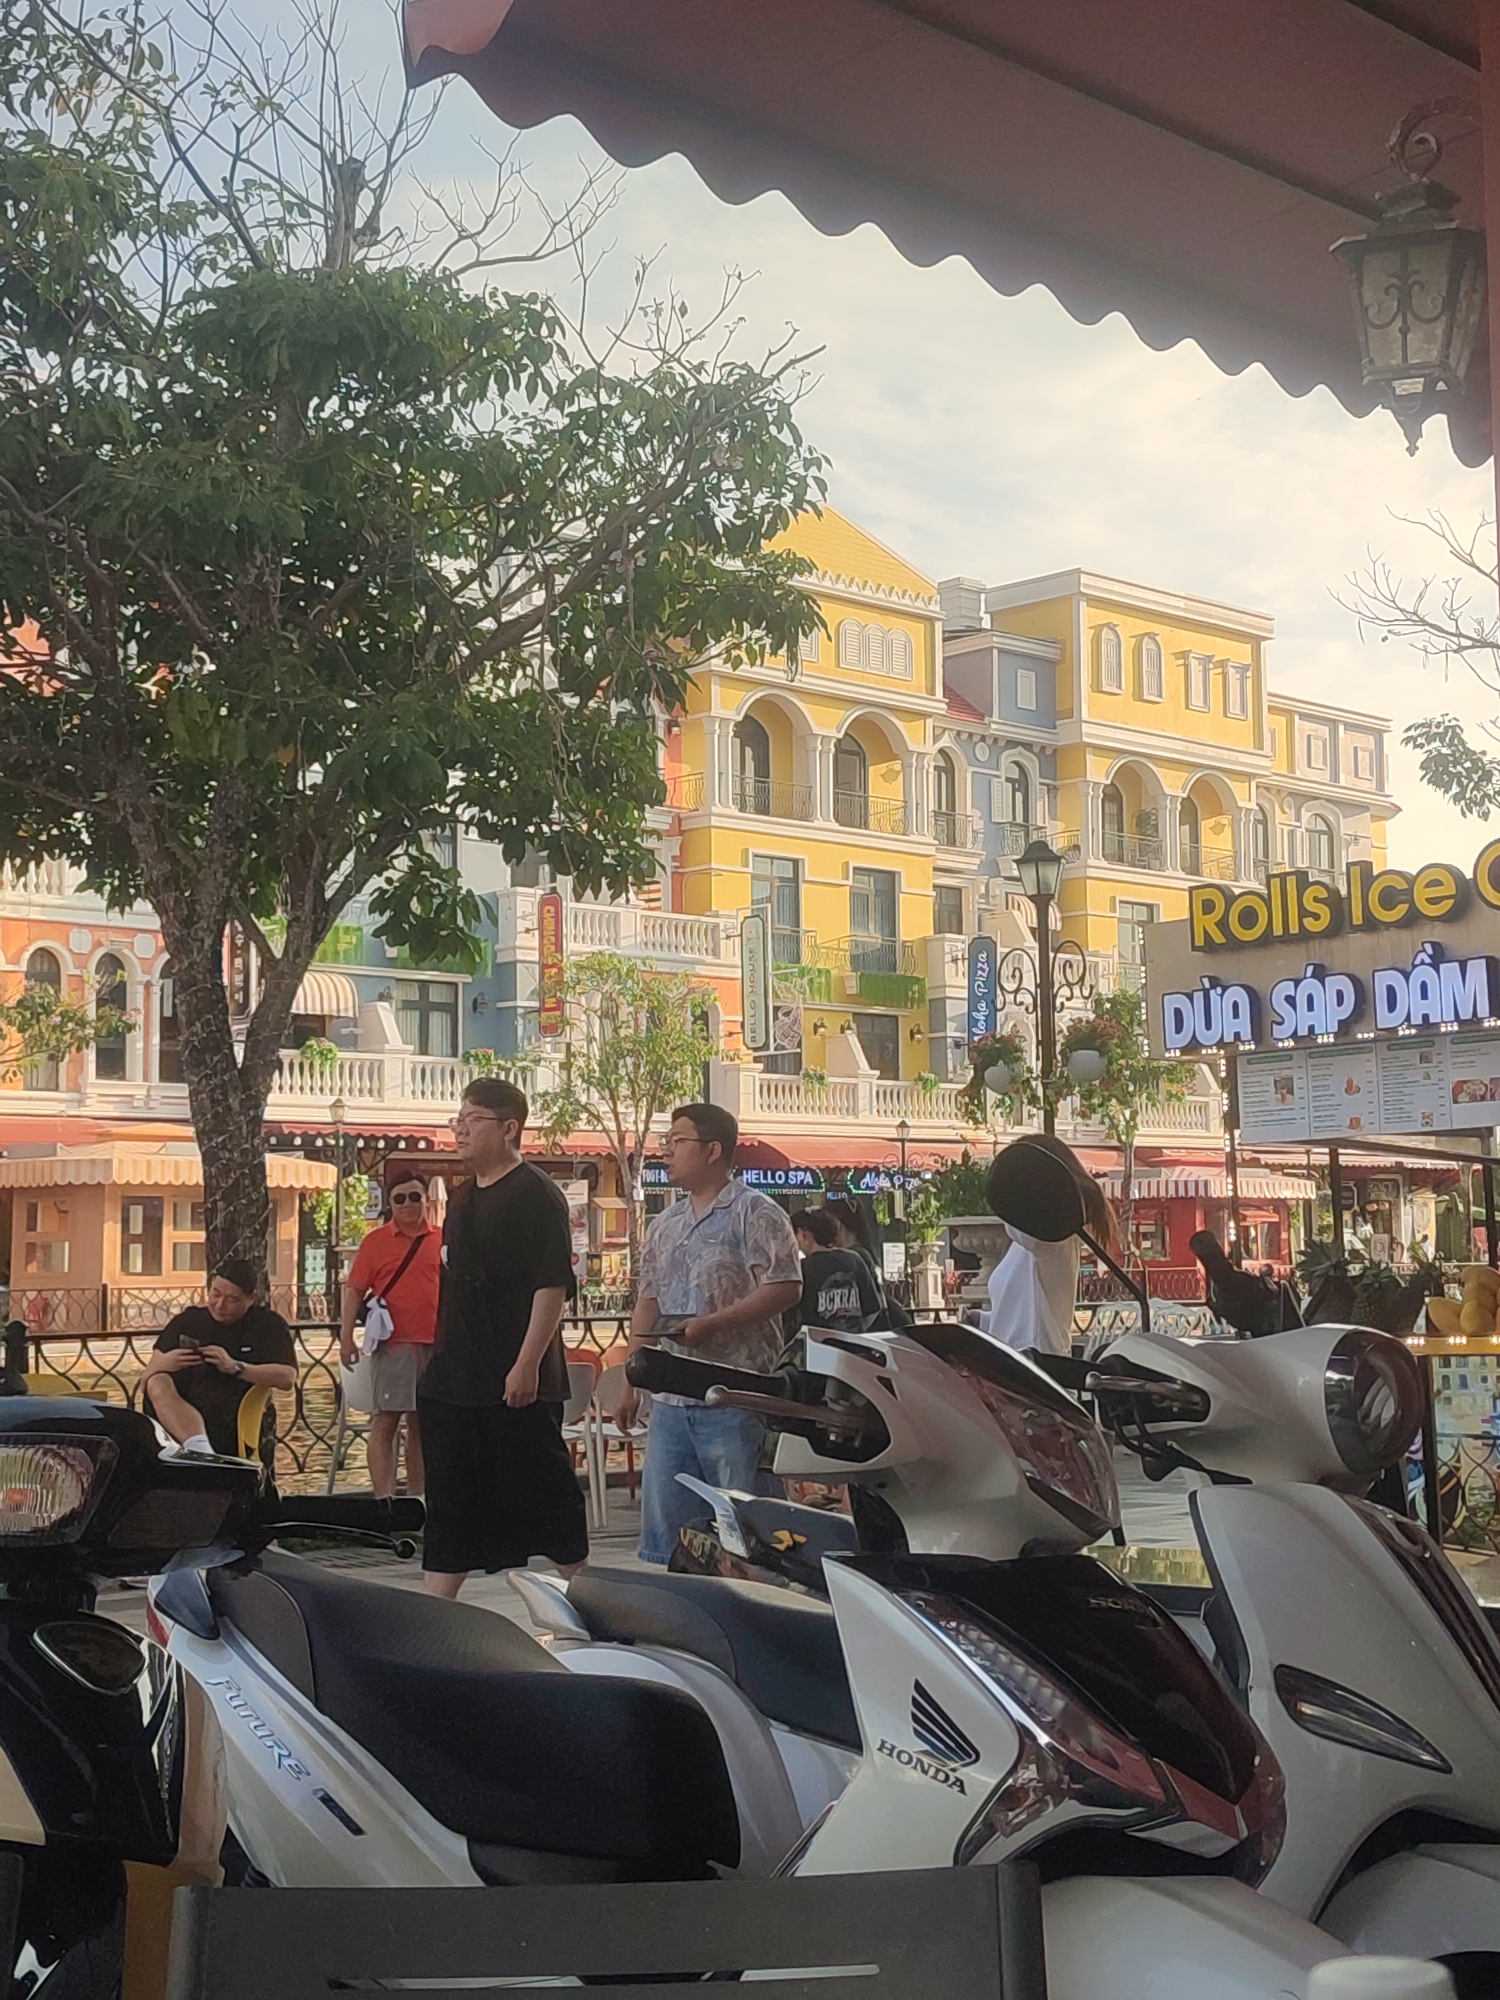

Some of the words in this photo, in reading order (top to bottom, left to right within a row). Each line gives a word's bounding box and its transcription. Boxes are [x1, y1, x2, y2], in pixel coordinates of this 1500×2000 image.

[1191, 873, 1333, 948] Rolls
[1350, 864, 1458, 927] Ice
[974, 949, 990, 997] Pizza
[1162, 977, 1252, 1050] DỪA
[1271, 964, 1356, 1039] SÁP
[1375, 942, 1491, 1030] DẦM
[742, 1169, 786, 1185] HELLO
[788, 1170, 814, 1185] SPA
[876, 1737, 968, 1797] HONDA
